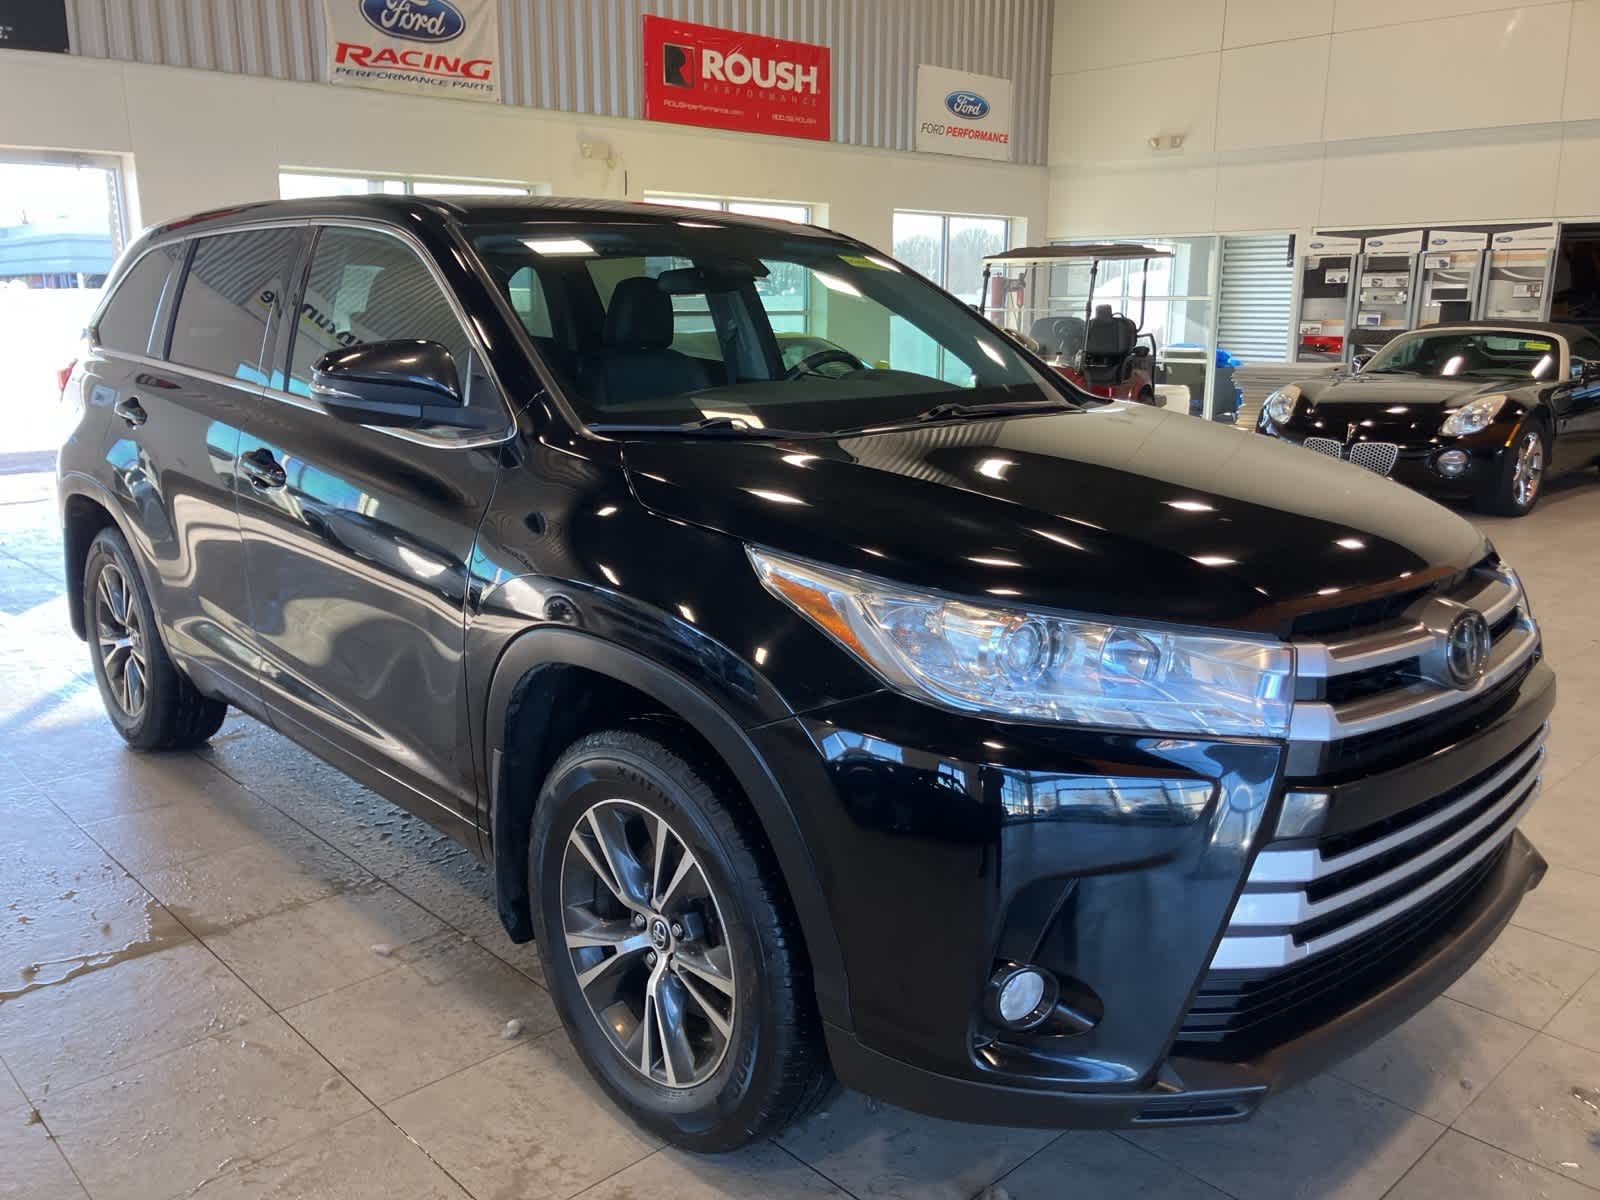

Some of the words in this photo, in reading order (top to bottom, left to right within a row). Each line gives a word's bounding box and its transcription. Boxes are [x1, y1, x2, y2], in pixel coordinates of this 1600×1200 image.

[381, 0, 446, 35] Ford
[335, 42, 492, 80] RACING
[702, 48, 818, 95] ROUSH
[336, 67, 448, 87] PERFORMANCE
[452, 80, 494, 92] PARTS
[953, 95, 982, 115] Ford
[921, 122, 945, 135] FORD
[945, 126, 1009, 144] PERFORMANCE
